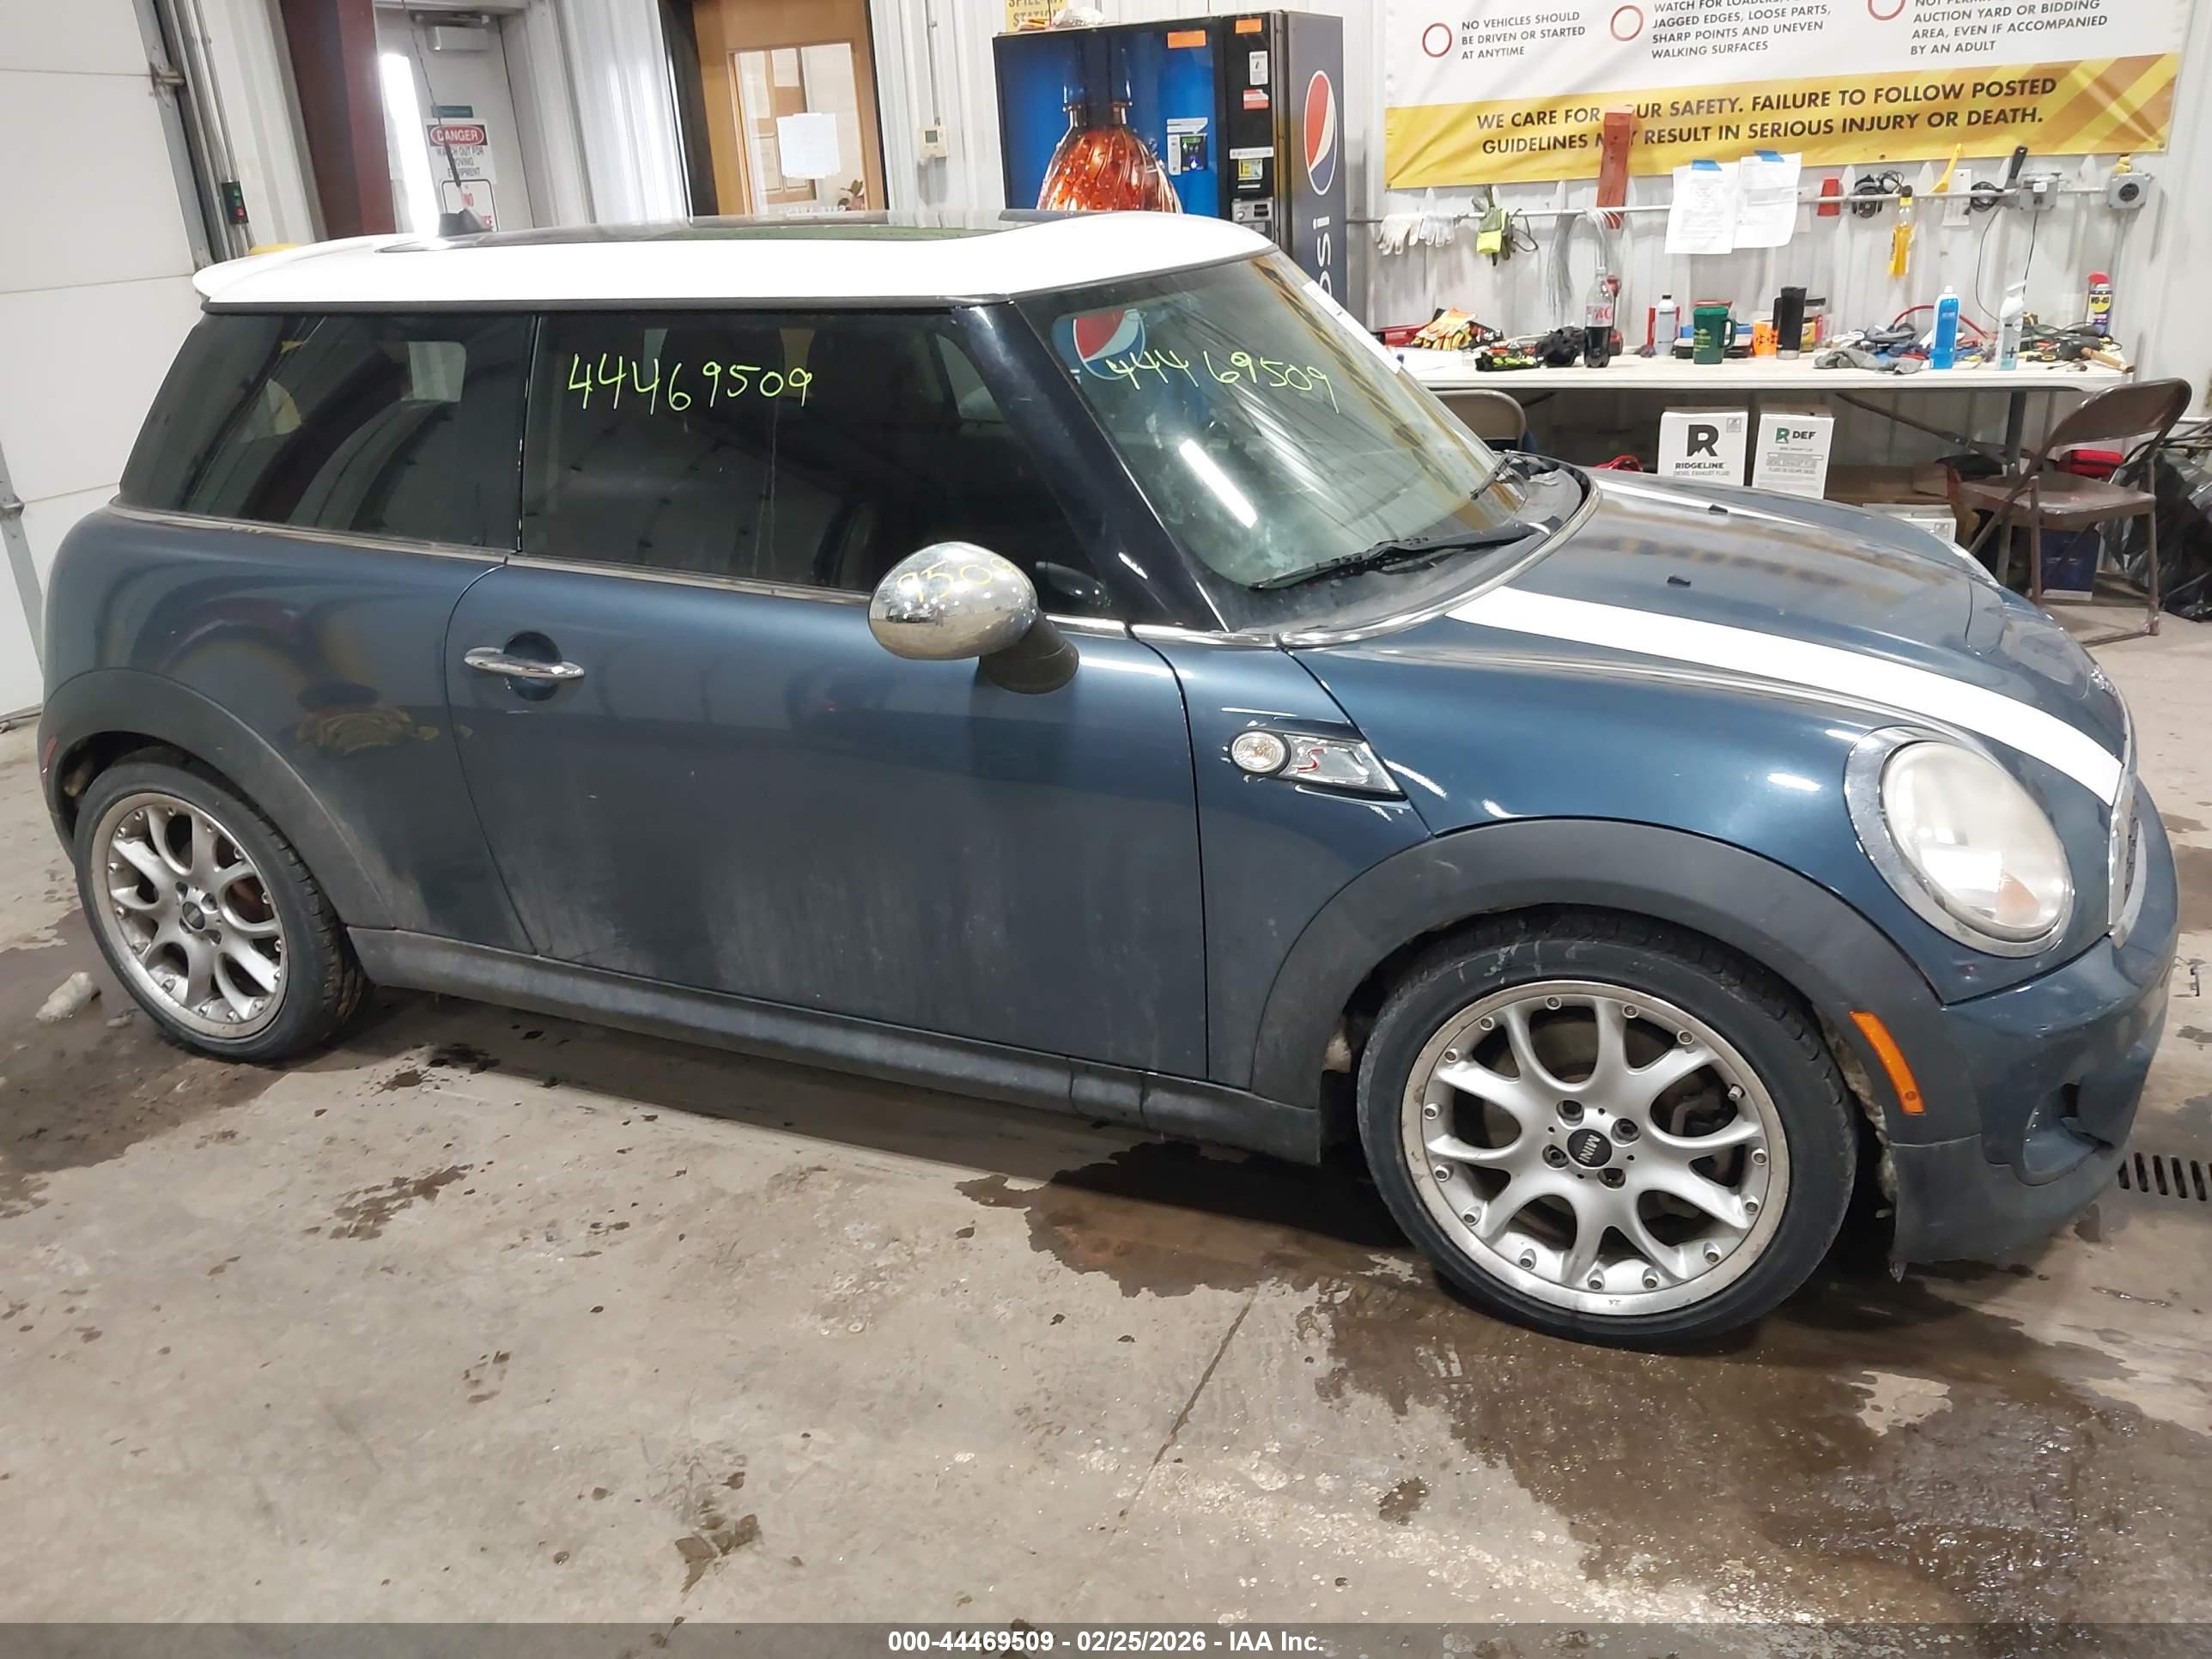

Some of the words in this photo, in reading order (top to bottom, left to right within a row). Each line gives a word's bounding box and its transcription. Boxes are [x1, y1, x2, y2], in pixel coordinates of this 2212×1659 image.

[1652, 15, 1700, 29] JAGGED
[1704, 12, 1744, 25] EDGES,
[1748, 9, 1787, 21] LOOSE
[1790, 4, 1832, 16] PARTS,
[1654, 1, 1695, 13] WATCH
[1913, 9, 1972, 23] AUCTION
[1977, 7, 2012, 18] YARD
[2016, 4, 2036, 15] OR
[2040, 0, 2101, 14] BIDDING
[1462, 20, 1480, 31] NO
[1483, 15, 1531, 28] VEHICLES
[1534, 11, 1580, 24] SHOULD
[1652, 32, 1692, 44] SHARP
[1694, 28, 1738, 41] POINTS
[1741, 25, 1769, 36] AND
[1773, 21, 1824, 34] UNEVEN
[1911, 27, 1950, 40] AREA,
[1954, 24, 1987, 37] EVEN
[1991, 22, 2004, 34] IF
[2006, 15, 2108, 33] ACCOMPANIED
[1462, 35, 1474, 46] BE
[1477, 32, 1517, 45] DRIVEN
[1520, 30, 1537, 41] OR
[1540, 26, 1586, 39] STARTED
[1462, 50, 1474, 60] AT
[1477, 46, 1525, 59] ANYTIME
[1651, 46, 1707, 59] WALKING
[1711, 40, 1769, 55] SURFACES
[1911, 44, 1926, 56] BY
[1930, 42, 1951, 54] AN
[1954, 40, 1996, 53] ADULT
[1476, 112, 1504, 130] WE
[1510, 108, 1558, 128] CARE
[1564, 106, 1601, 125] FOR
[1668, 96, 1744, 117] SAFETY.
[1752, 90, 1831, 112] FAILURE
[1838, 87, 1866, 106] TO
[1874, 82, 1965, 104] FOLLOW
[1972, 76, 2057, 99] POSTED
[436, 129, 479, 142] DANGER
[1482, 133, 1588, 155] GUIDELINES
[1644, 126, 1713, 145] RESULT
[1718, 125, 1741, 141] IN
[1747, 118, 1834, 139] SERIOUS
[1841, 112, 1920, 134] INJURY
[1927, 110, 1959, 128] OR
[1966, 106, 2044, 126] DEATH.
[568, 352, 812, 416] 44469509
[1105, 349, 1340, 414] 44469509
[1792, 430, 1816, 440] DEF
[1578, 1133, 1601, 1164] MINI
